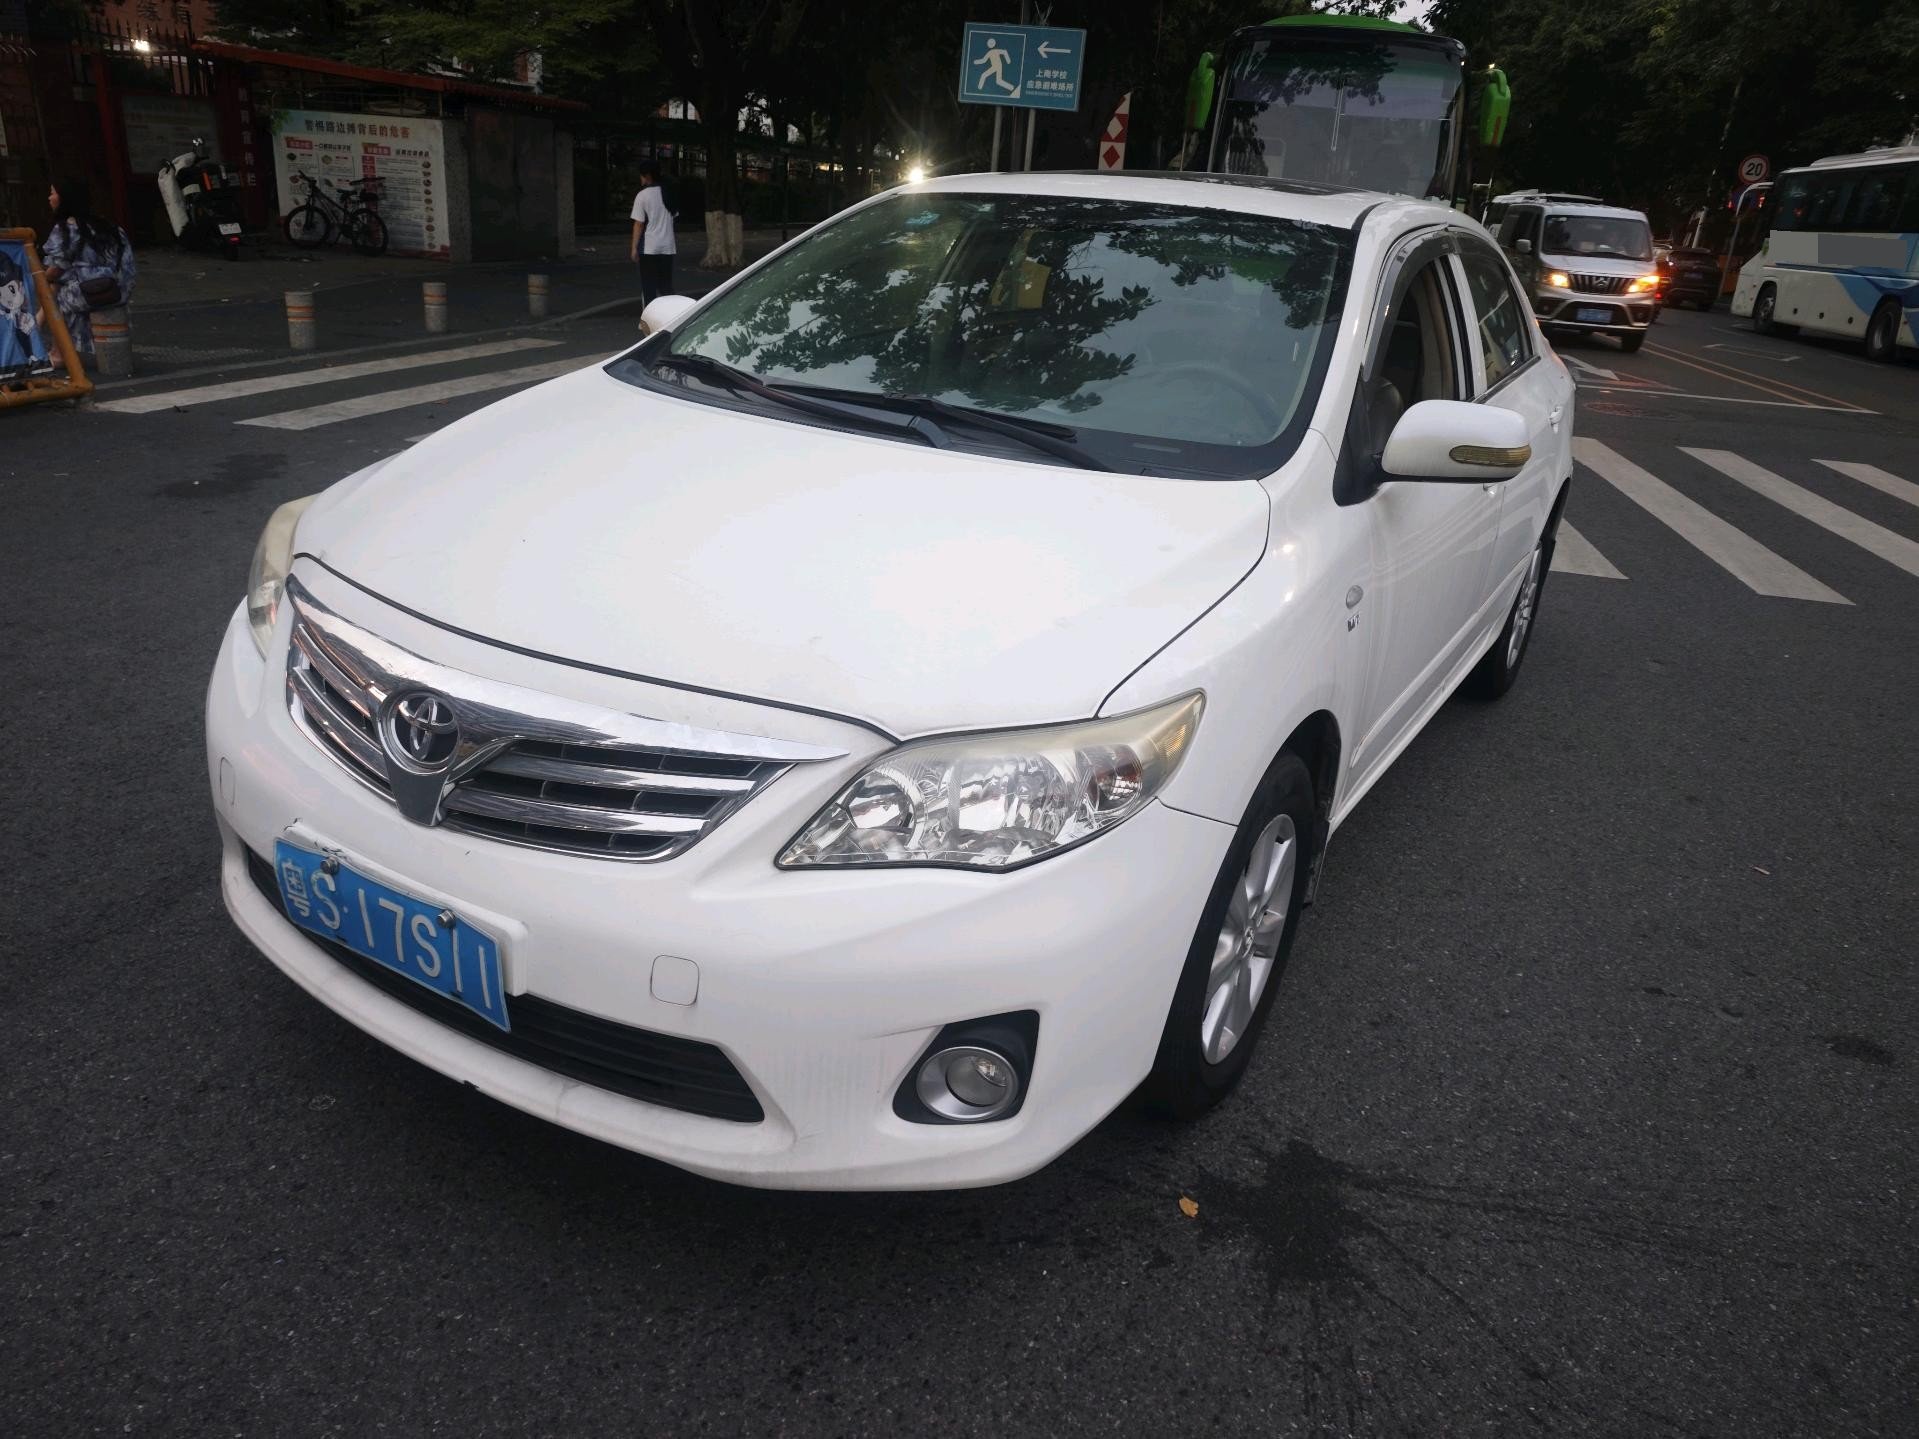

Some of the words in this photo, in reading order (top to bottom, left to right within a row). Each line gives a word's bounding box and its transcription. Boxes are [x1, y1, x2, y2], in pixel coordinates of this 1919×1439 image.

[304, 119, 410, 139] 警惕路边摊背后的危害
[1746, 162, 1763, 176] 20
